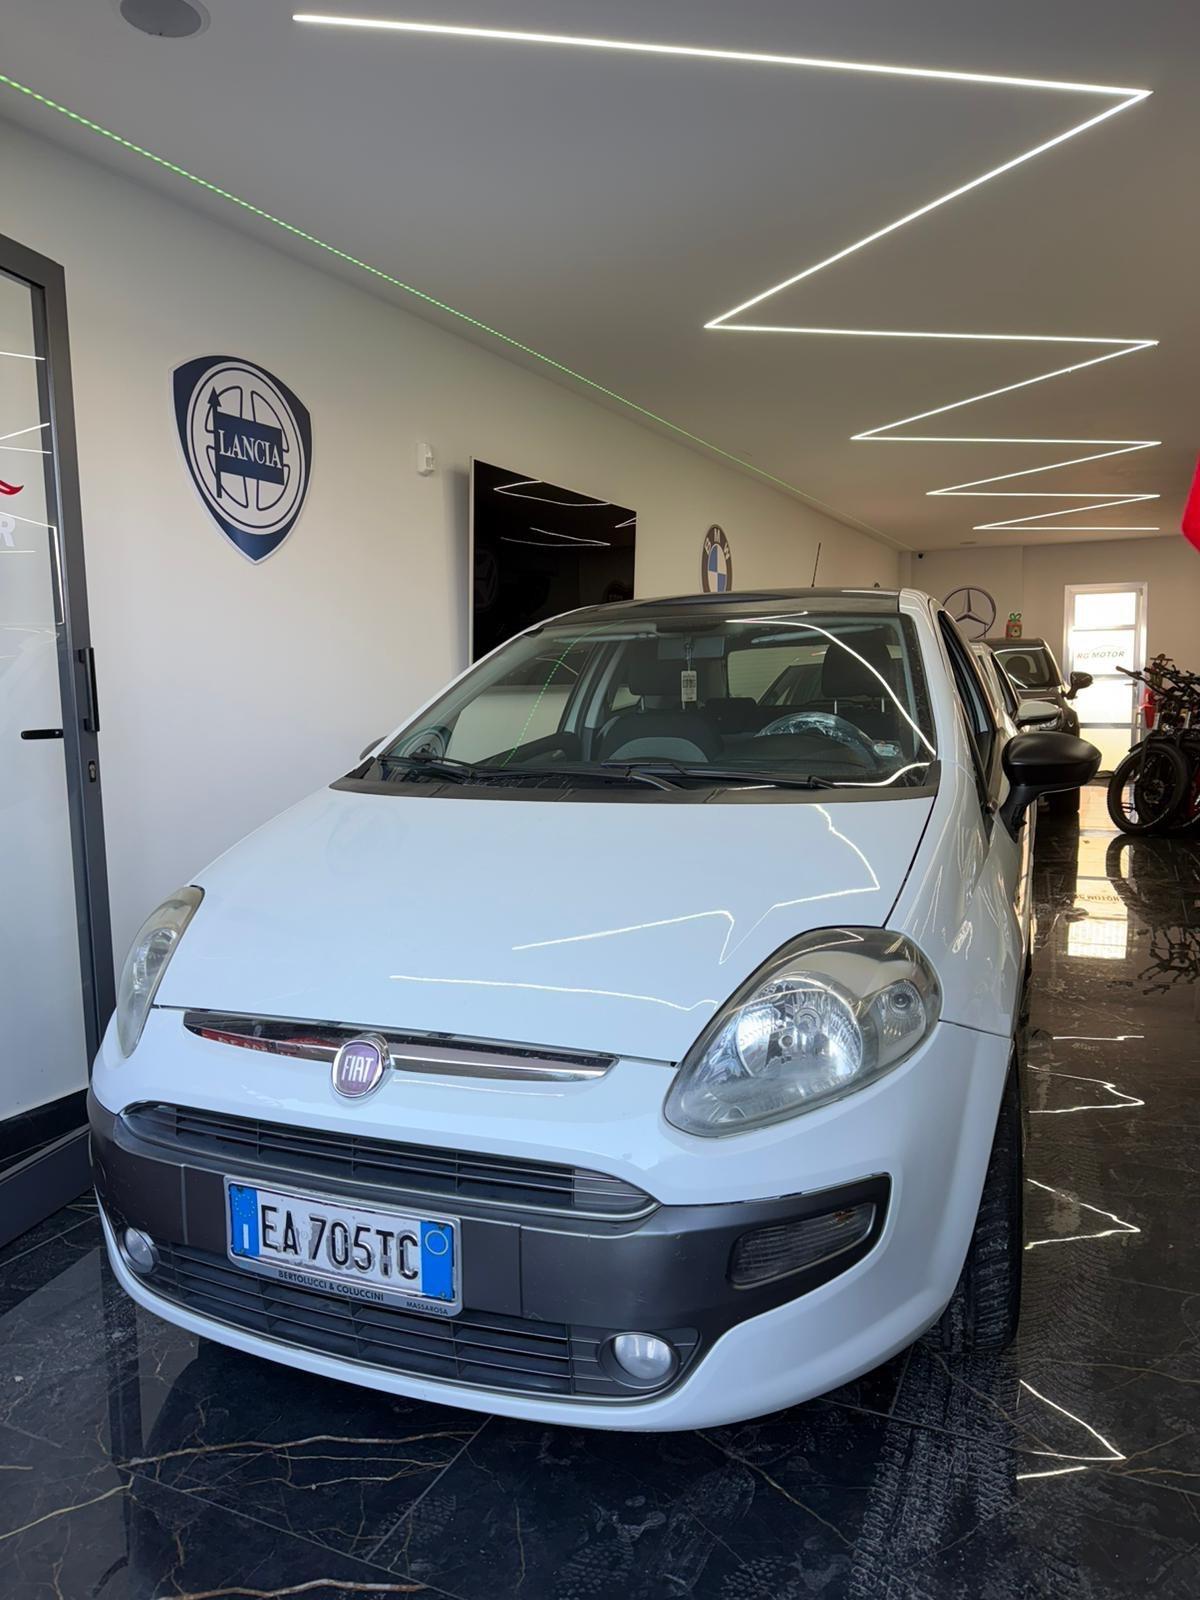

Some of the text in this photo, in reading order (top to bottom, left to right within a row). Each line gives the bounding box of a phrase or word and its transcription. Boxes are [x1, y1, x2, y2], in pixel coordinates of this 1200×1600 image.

[218, 429, 283, 469] LANCIA
[704, 527, 730, 560] BMW
[1091, 650, 1126, 658] MOTOR
[341, 1055, 375, 1083] FIAT
[261, 1205, 419, 1280] EA 705TC
[278, 1270, 385, 1302] BERTOLUCCI & COLUCCINI
[406, 1300, 449, 1316] MASSAROSA
